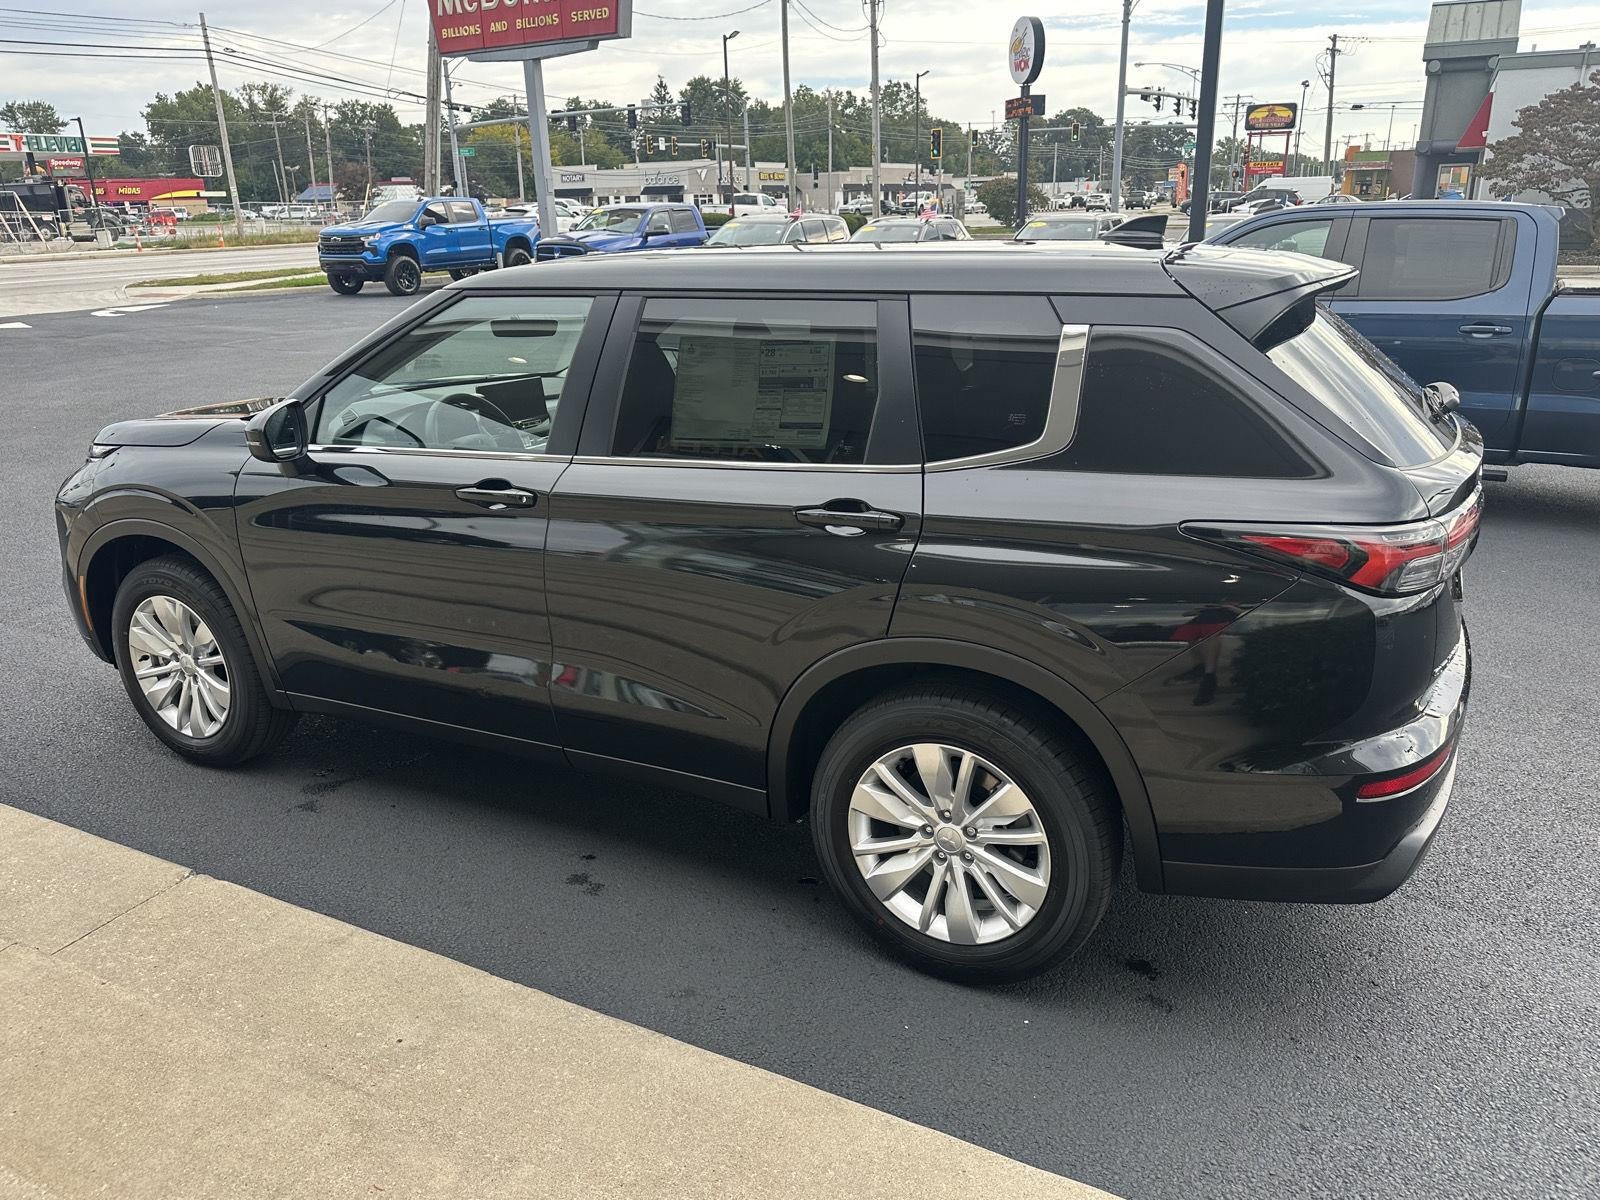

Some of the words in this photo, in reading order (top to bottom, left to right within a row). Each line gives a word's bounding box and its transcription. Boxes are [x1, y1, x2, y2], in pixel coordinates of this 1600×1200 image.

[442, 24, 481, 39] BILLIONS
[490, 21, 508, 33] AND
[516, 13, 560, 30] BILLIONS
[571, 7, 609, 22] SERVED
[51, 159, 82, 168] Speedway
[562, 174, 583, 182] NOTARY
